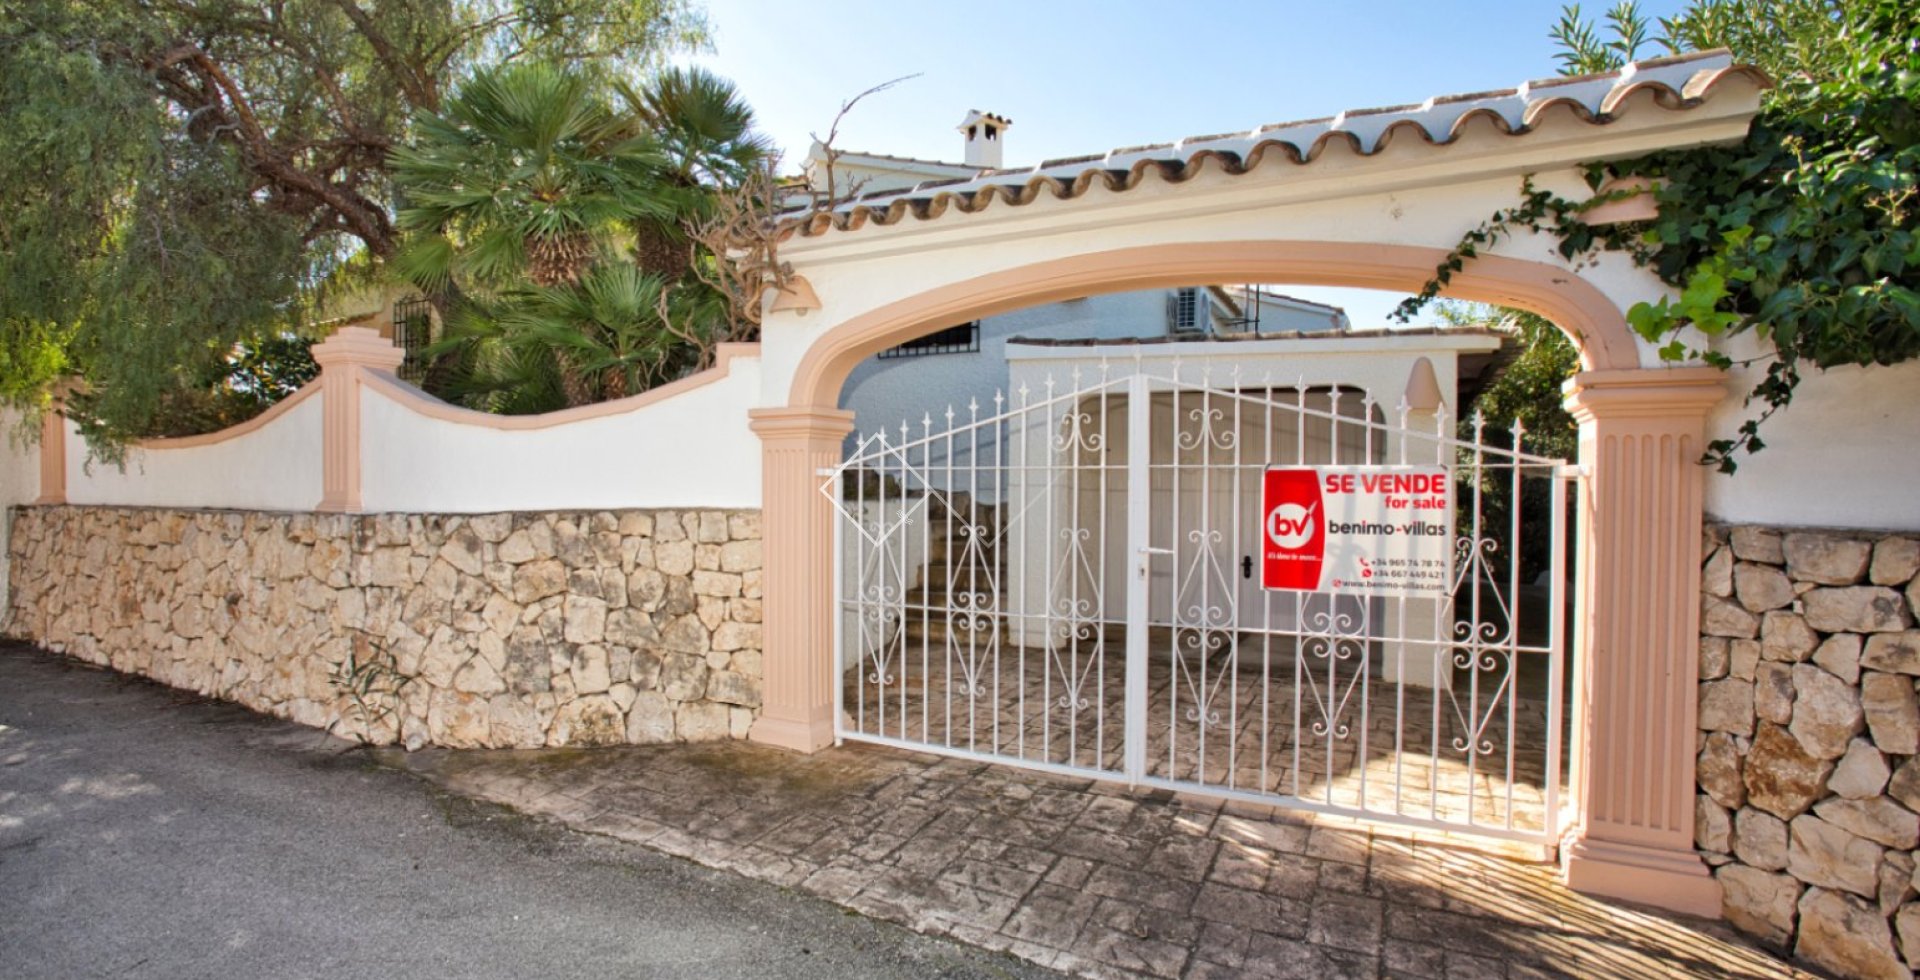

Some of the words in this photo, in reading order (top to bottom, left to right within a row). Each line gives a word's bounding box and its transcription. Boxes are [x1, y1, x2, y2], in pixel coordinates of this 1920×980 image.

[1325, 474, 1355, 494] SE
[1360, 474, 1446, 494] VENDE
[1384, 495, 1407, 509] for
[1412, 496, 1446, 510] sale
[1274, 508, 1313, 536] bv
[1328, 520, 1446, 536] benimo-villas
